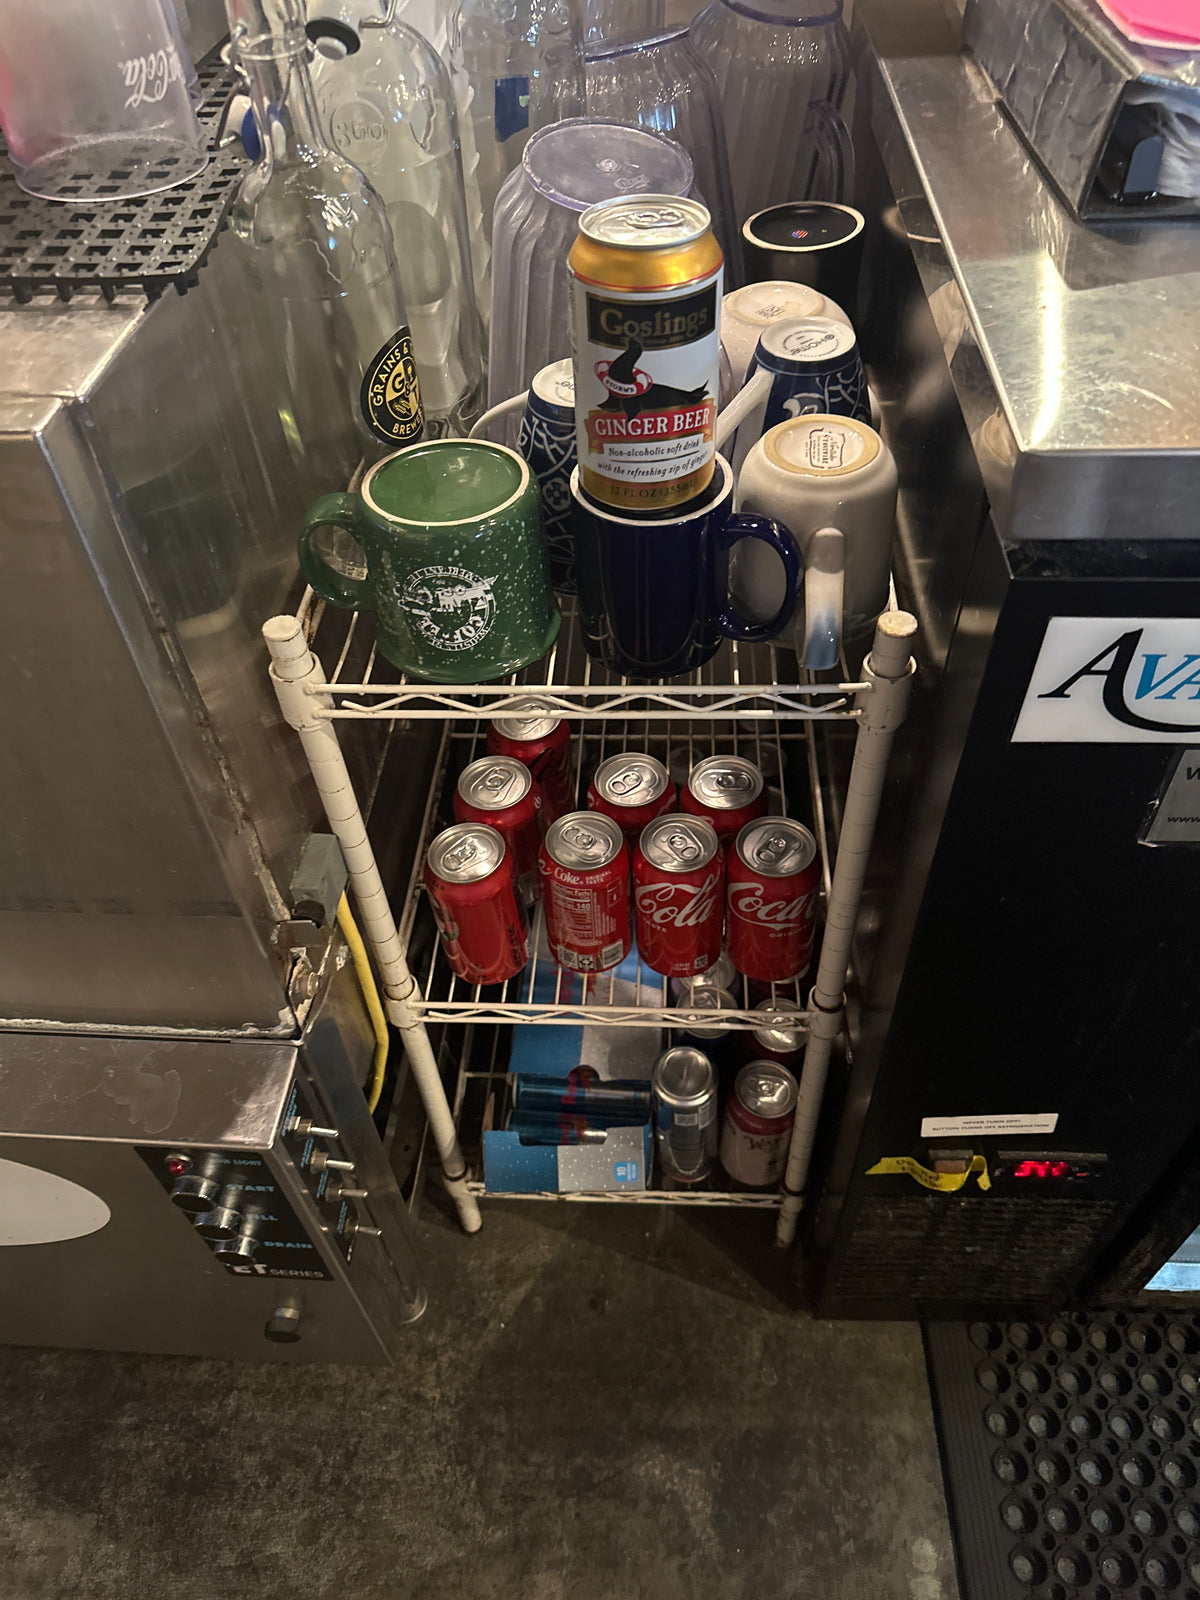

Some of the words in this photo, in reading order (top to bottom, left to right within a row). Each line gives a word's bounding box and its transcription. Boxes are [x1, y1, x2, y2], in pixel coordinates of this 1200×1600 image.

[600, 307, 708, 338] Goslings
[372, 348, 401, 407] GRAINS
[391, 372, 406, 394] G
[595, 415, 668, 436] GINGER
[673, 407, 710, 432] BEER
[608, 444, 665, 457] Non-alcoholic
[666, 442, 682, 456] soft
[683, 438, 700, 452] drink
[597, 462, 612, 472] with
[613, 464, 625, 475] the
[626, 467, 668, 480] refreshing
[668, 464, 681, 475] zip
[681, 459, 691, 470] of
[554, 861, 580, 885] Coke
[585, 870, 612, 881] ORIGINAL
[585, 877, 604, 886] TASTE
[635, 868, 720, 928] Cola
[616, 1165, 627, 1177] 10
[226, 1183, 275, 1193] START
[263, 1240, 314, 1250] DRAIN
[270, 1267, 325, 1279] SERIES
